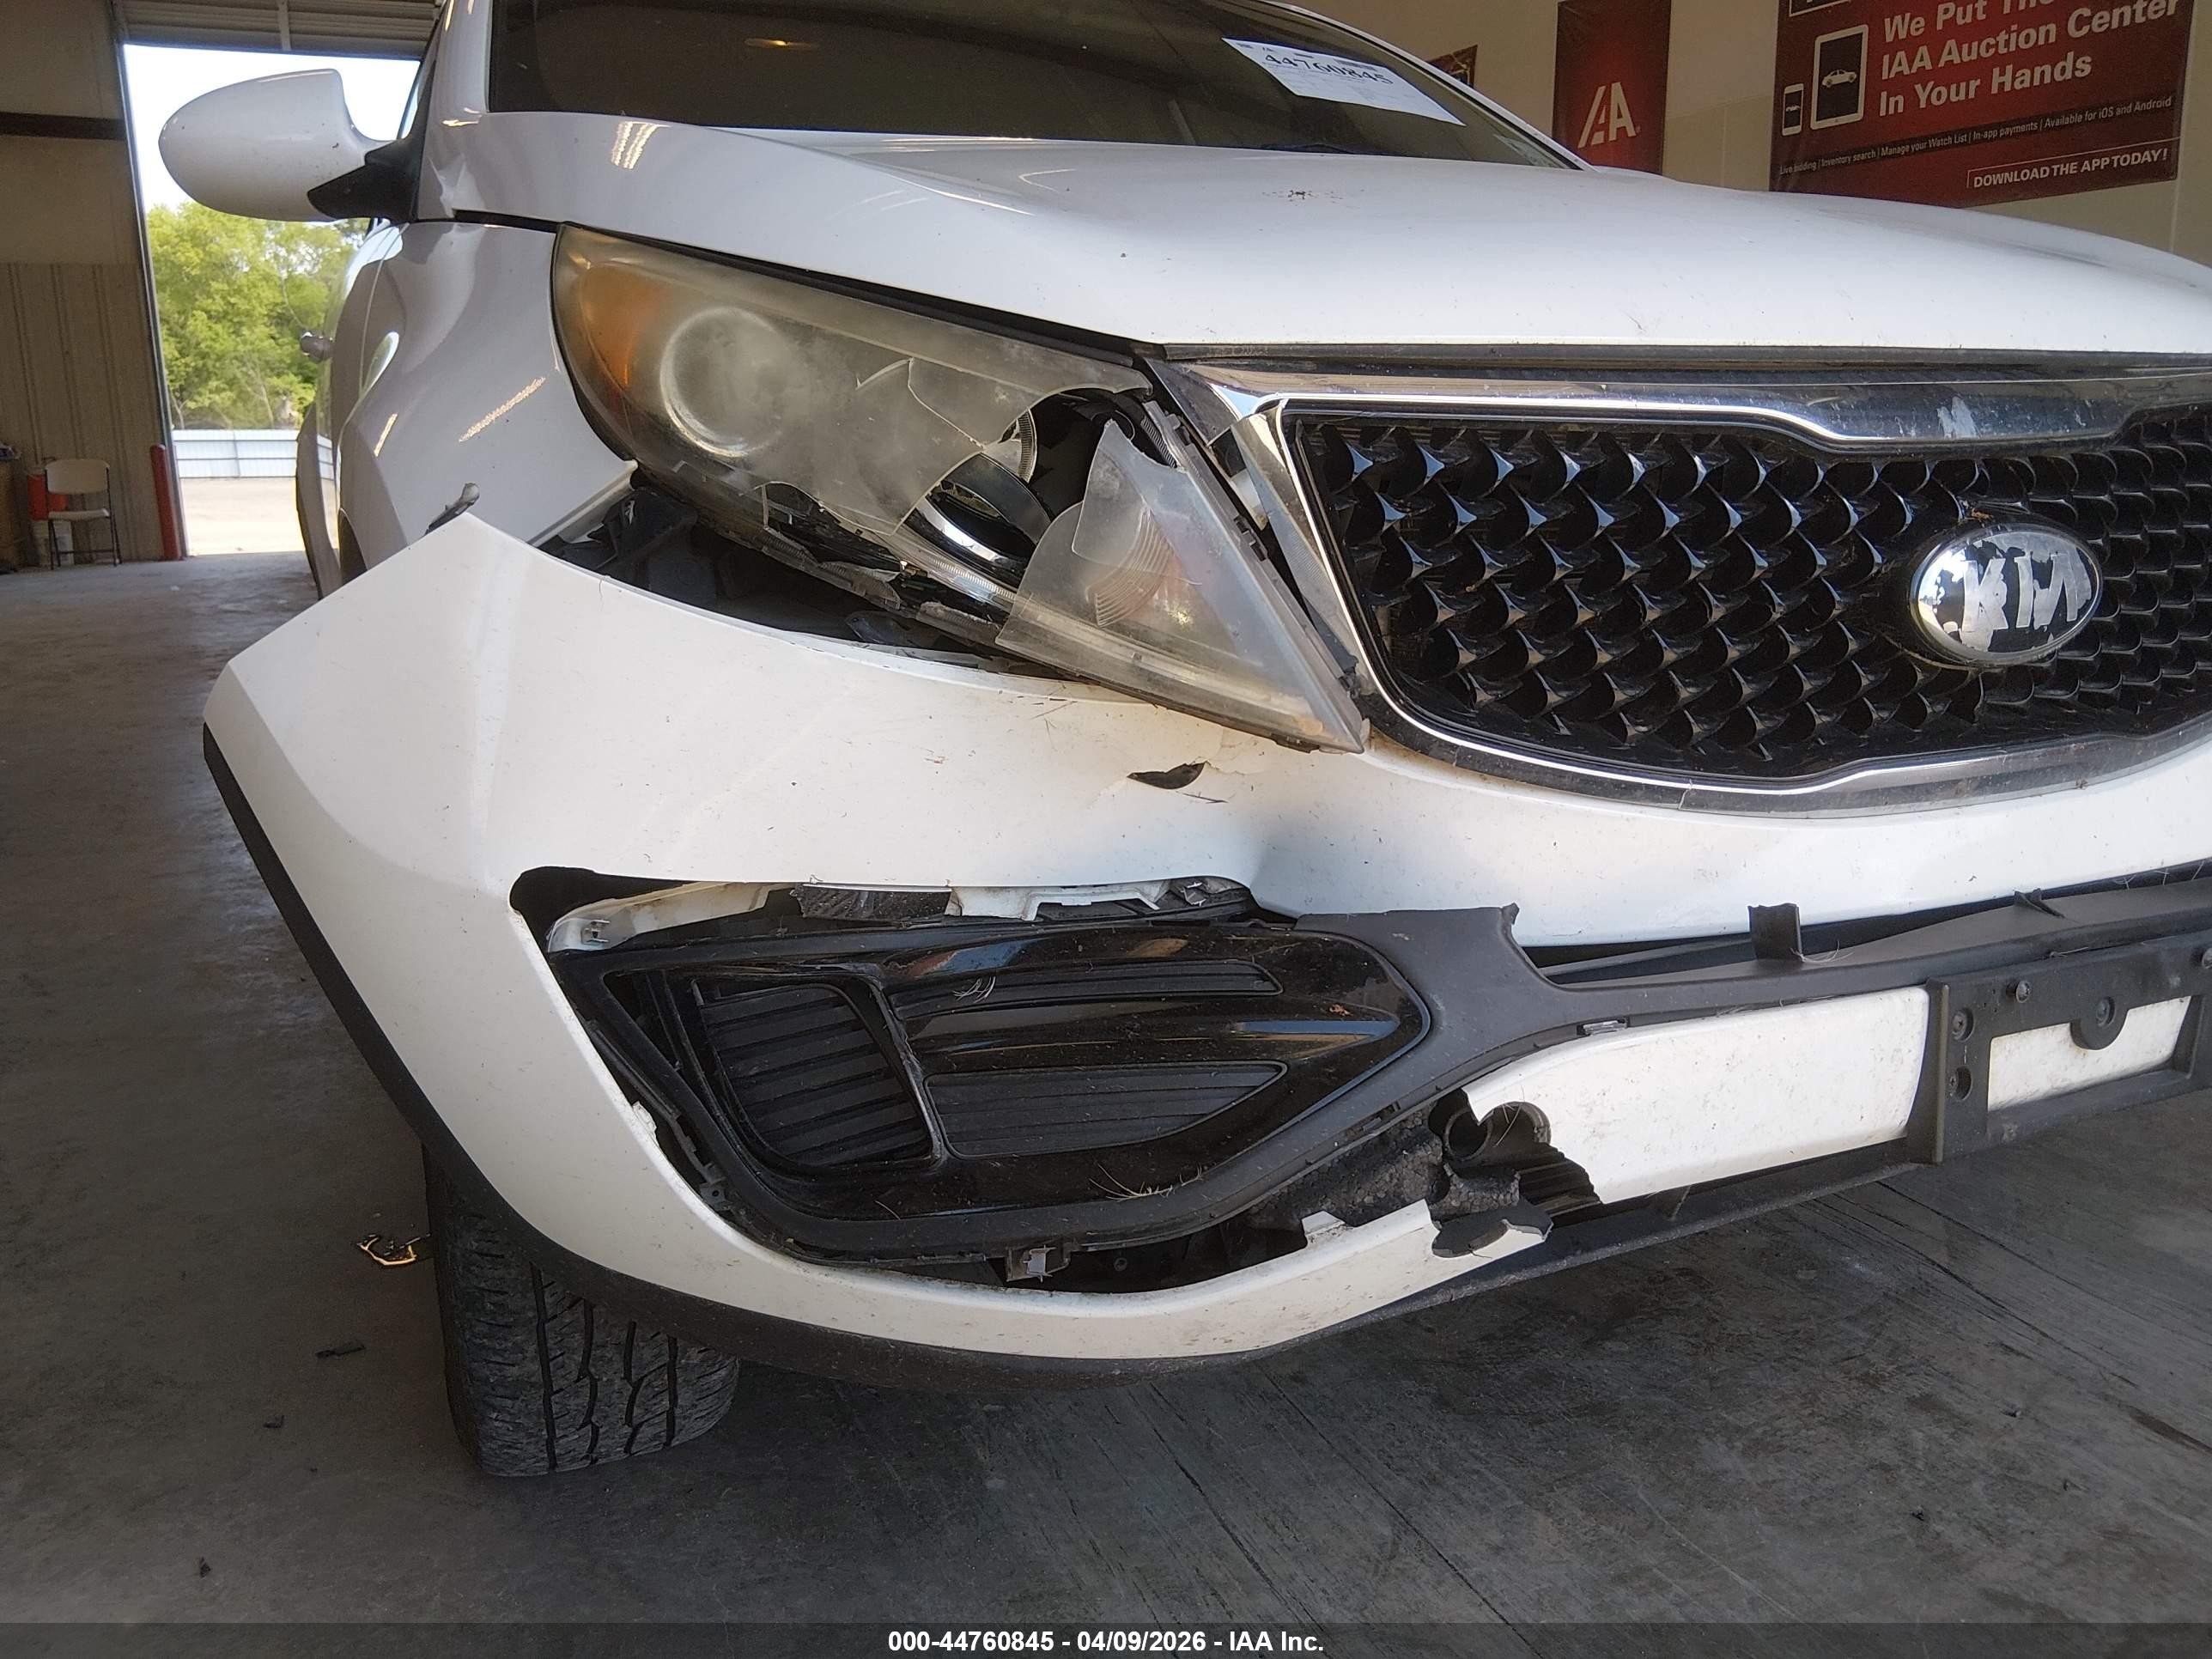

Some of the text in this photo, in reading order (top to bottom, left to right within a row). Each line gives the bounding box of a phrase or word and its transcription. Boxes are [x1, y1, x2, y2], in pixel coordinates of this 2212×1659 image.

[1881, 0, 2179, 81] IAA Auction Center
[1884, 12, 1925, 43] We
[1936, 0, 1987, 31] Put
[1264, 52, 1394, 84] 44760845
[1879, 51, 2093, 117] In Your Hands
[1852, 149, 1876, 161] search
[1881, 143, 1911, 156] Manage
[1911, 142, 1927, 153] your
[1929, 136, 1953, 149] Watch
[1954, 134, 1967, 145] List
[1972, 130, 1998, 142] In-app
[1999, 121, 2039, 137] payments
[2044, 113, 2082, 129] Available
[2084, 110, 2098, 122] for
[2099, 106, 2114, 118] iOS
[2116, 103, 2132, 115] and
[2134, 95, 2172, 112] Android
[1973, 148, 2169, 189] DOWNLOAD THE APP TODAY!
